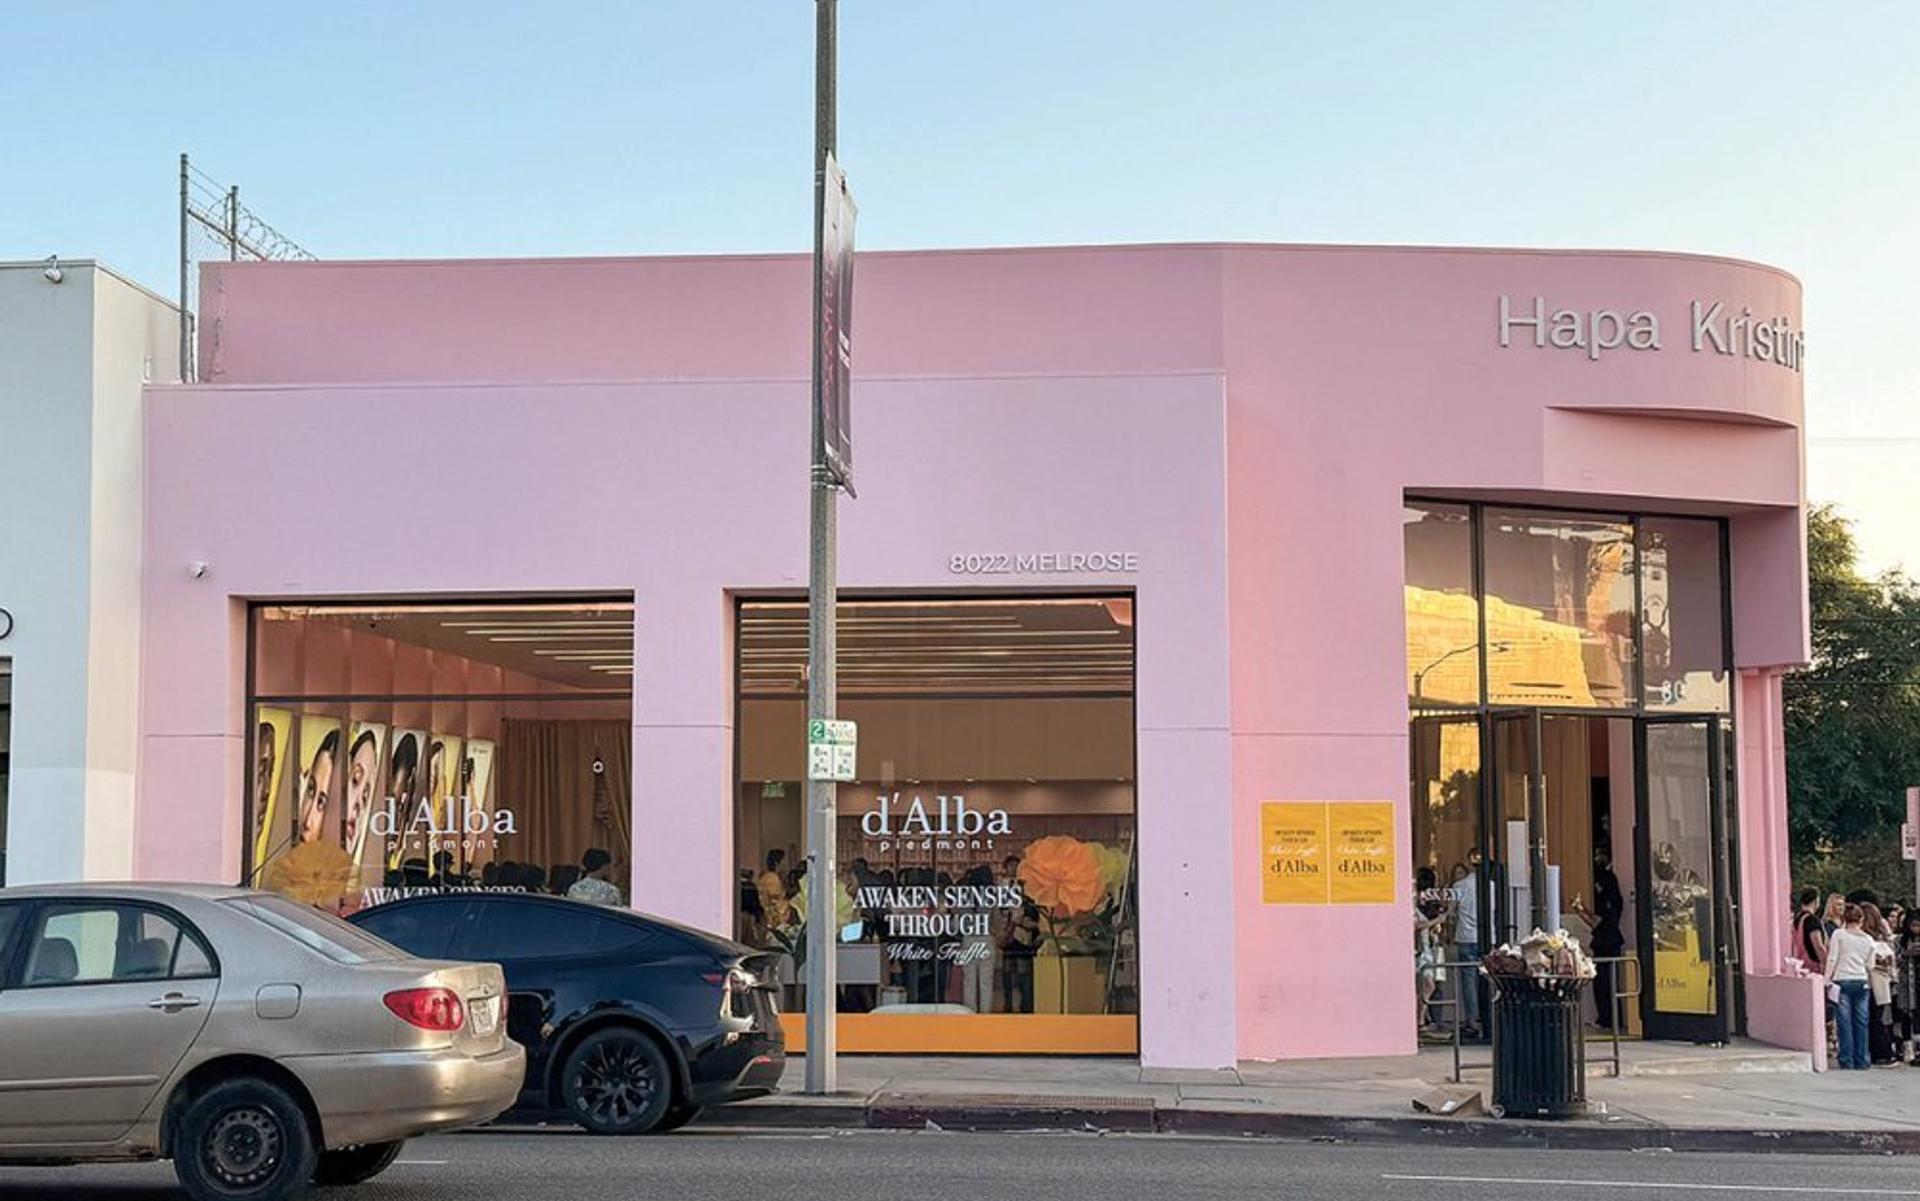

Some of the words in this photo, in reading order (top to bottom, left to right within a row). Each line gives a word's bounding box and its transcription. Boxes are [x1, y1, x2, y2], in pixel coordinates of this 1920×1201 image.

[1498, 296, 1662, 361] Hapa
[950, 553, 1010, 573] 8022
[1016, 552, 1138, 572] MELROSE
[369, 792, 517, 836] d'Alba
[862, 792, 1012, 835] d'Alba
[880, 838, 994, 852] piedmont
[852, 886, 939, 909] AWAKEN
[944, 885, 1023, 908] SENSES
[884, 914, 990, 936] THROUGH
[886, 942, 934, 961] White
[937, 942, 990, 965] Truffle
